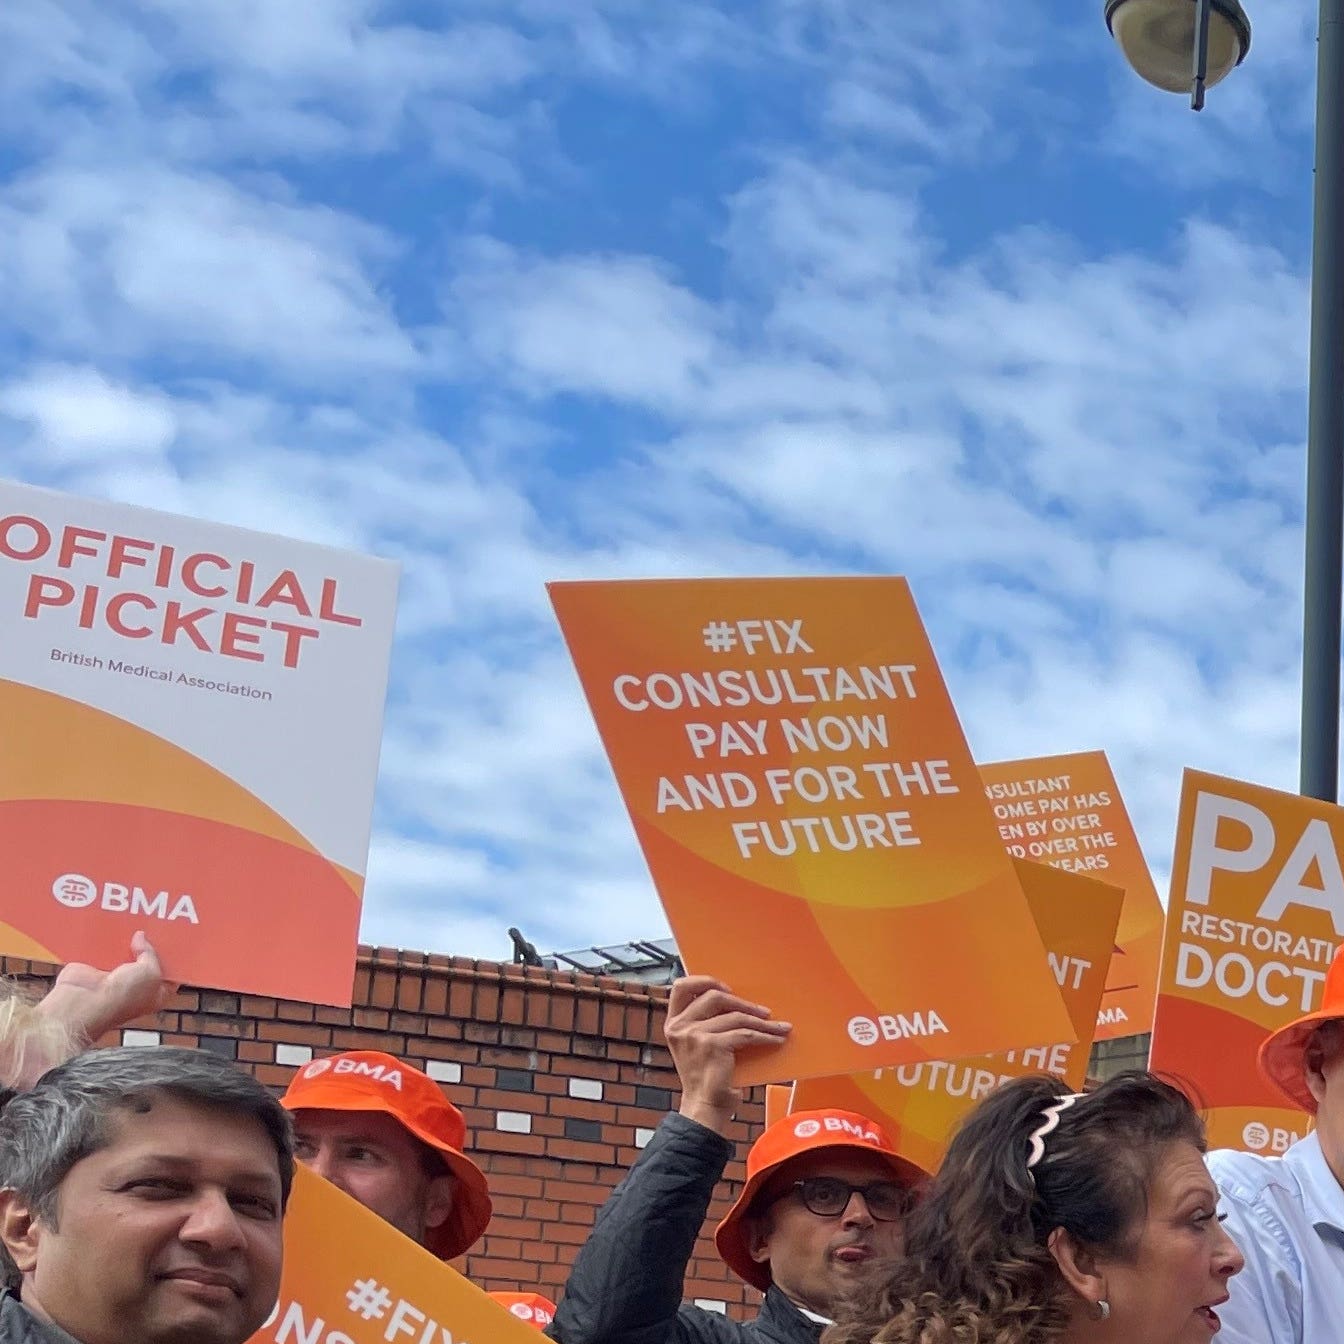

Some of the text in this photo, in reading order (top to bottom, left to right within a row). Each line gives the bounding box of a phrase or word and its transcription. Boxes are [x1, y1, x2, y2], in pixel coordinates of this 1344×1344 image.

[0, 515, 363, 627] OFFICIAL
[23, 573, 321, 669] PICKET
[702, 619, 815, 655] #FIX
[50, 648, 273, 701] British Medical Association
[613, 664, 918, 712] CONSULTANT
[685, 714, 889, 759] PAY NOW
[656, 760, 960, 813] AND FOR THE
[985, 775, 1071, 800] NSULTANT
[994, 791, 1112, 819] OME PAY HAS
[731, 811, 921, 859] FUTURE
[1026, 820, 1048, 836] BY
[1052, 814, 1102, 833] OVER
[1029, 838, 1079, 857] OVER
[1079, 832, 1118, 850] THE
[101, 881, 199, 925] BMA
[1181, 909, 1335, 965] RESTORATI
[1176, 942, 1327, 1013] DOCT
[878, 1010, 950, 1041] BMA
[1096, 1007, 1129, 1026] MA
[334, 1058, 402, 1091] BMA
[823, 1117, 881, 1146] BMA
